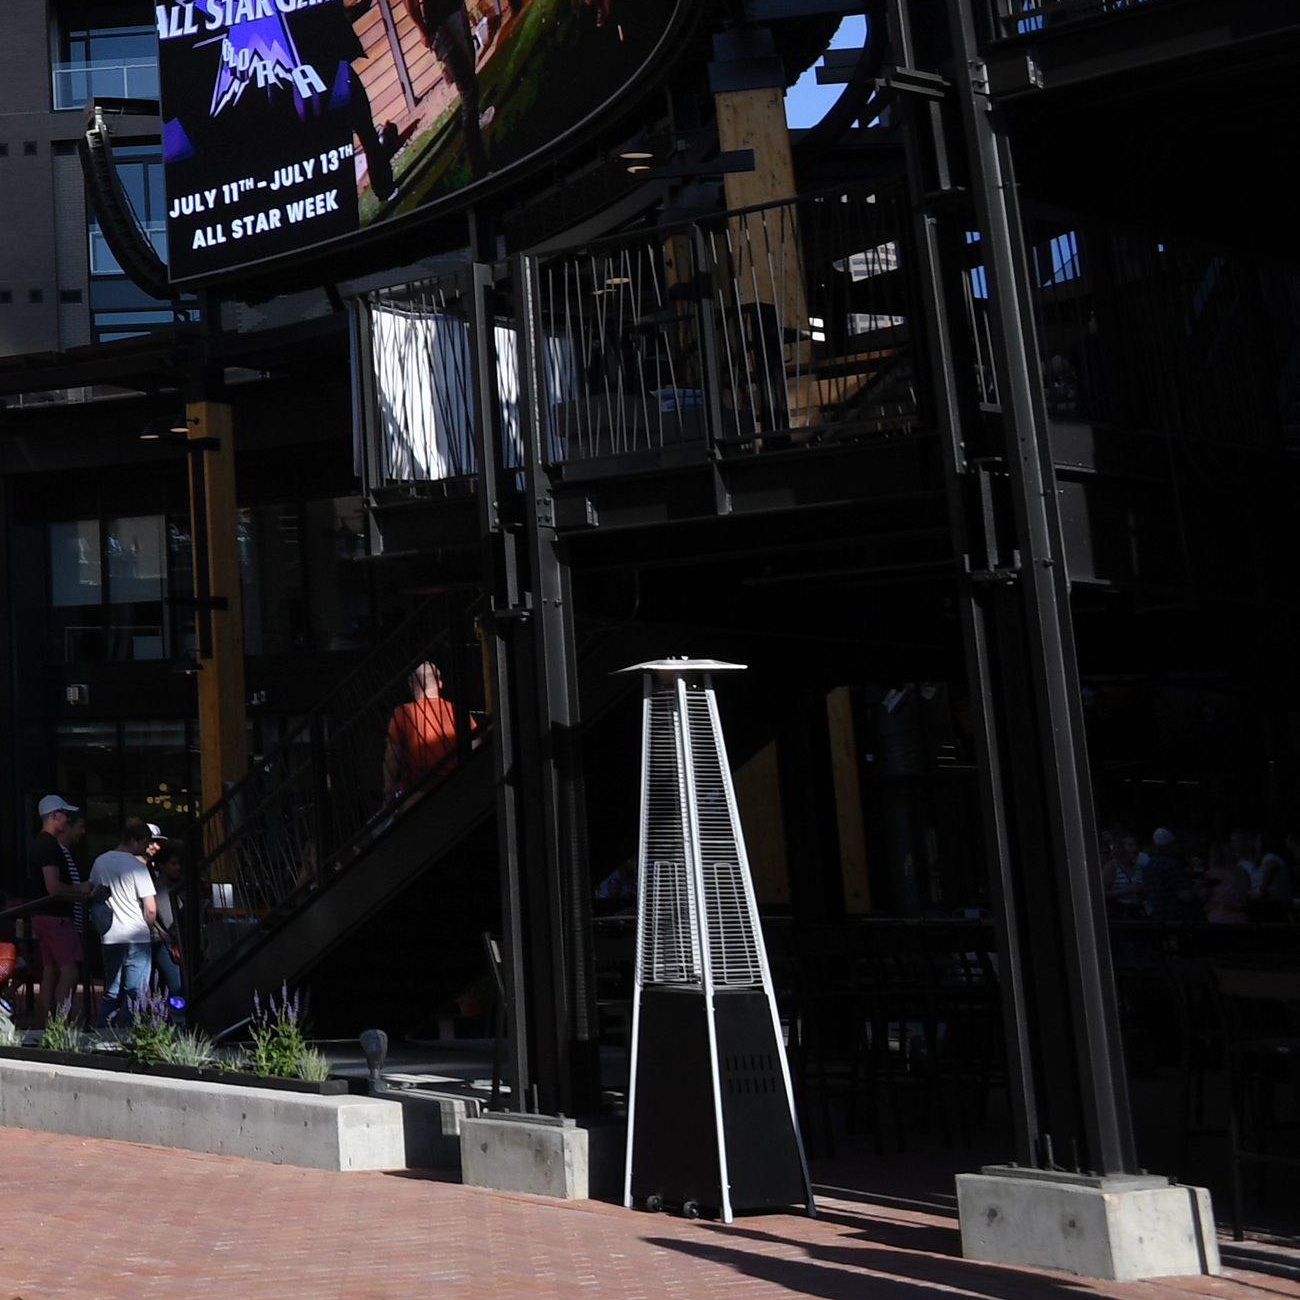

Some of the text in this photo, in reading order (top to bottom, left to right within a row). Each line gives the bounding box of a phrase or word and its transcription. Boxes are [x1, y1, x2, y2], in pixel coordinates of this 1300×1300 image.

[155, 4, 199, 40] ALL
[169, 188, 217, 218] JULY
[221, 177, 255, 204] 11TH
[269, 158, 315, 191] JULY
[319, 143, 354, 174] 13TH
[191, 188, 339, 249] ALL STAR WEEK
